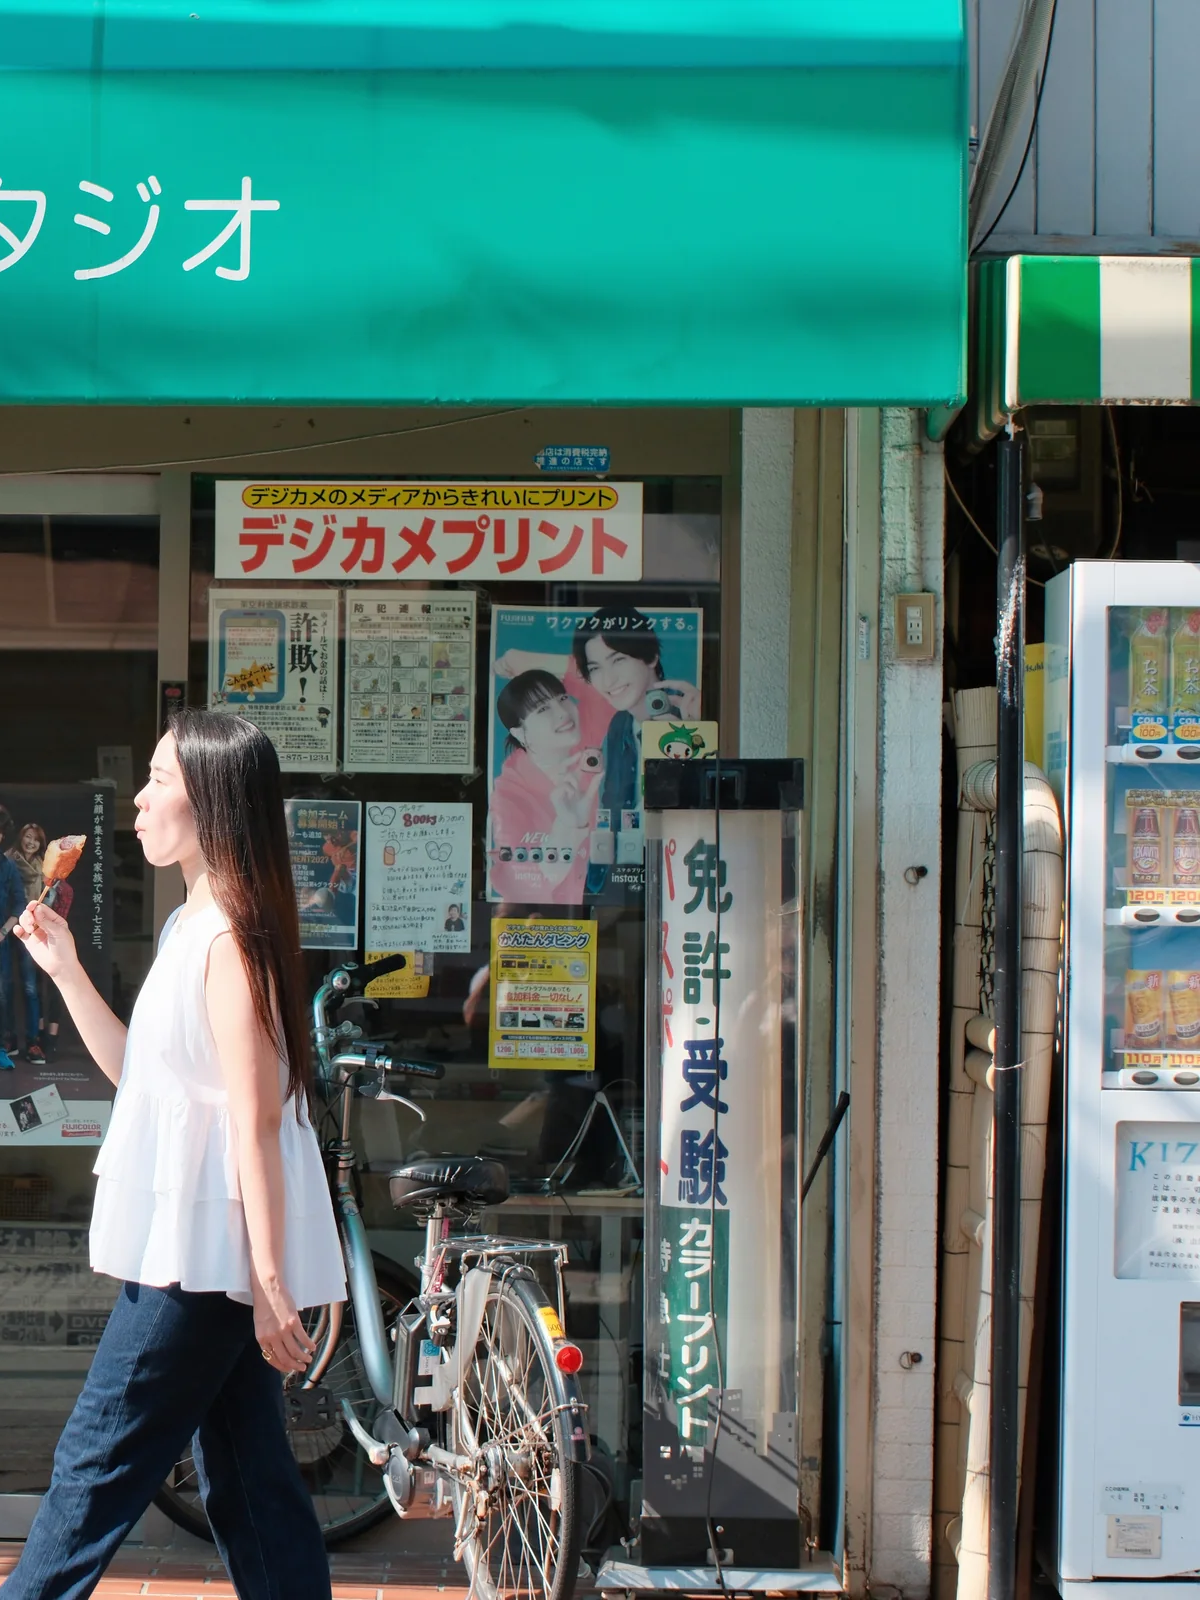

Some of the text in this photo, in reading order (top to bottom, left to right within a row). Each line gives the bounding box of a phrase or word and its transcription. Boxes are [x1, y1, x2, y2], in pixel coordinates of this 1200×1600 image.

[250, 486, 614, 509] デジカメのメディアからきれいにプリント
[238, 514, 629, 576] デジカメプリント
[353, 603, 432, 614] 防犯速報
[546, 615, 694, 632] ワクワクがリンクする。
[1140, 659, 1160, 696] お茶
[1137, 716, 1164, 725] COLD
[297, 809, 349, 820] 参加チーム
[91, 794, 105, 951] 笑顔が集まる。家族で祝う七五三。
[611, 872, 639, 884] instax
[1128, 890, 1165, 901] 120円
[497, 931, 590, 949] かんたんダビング
[1147, 974, 1159, 988] 新
[1126, 1053, 1162, 1064] 110円
[61, 1123, 102, 1131] FUJICOLOR
[677, 1217, 717, 1440] カラープリント
